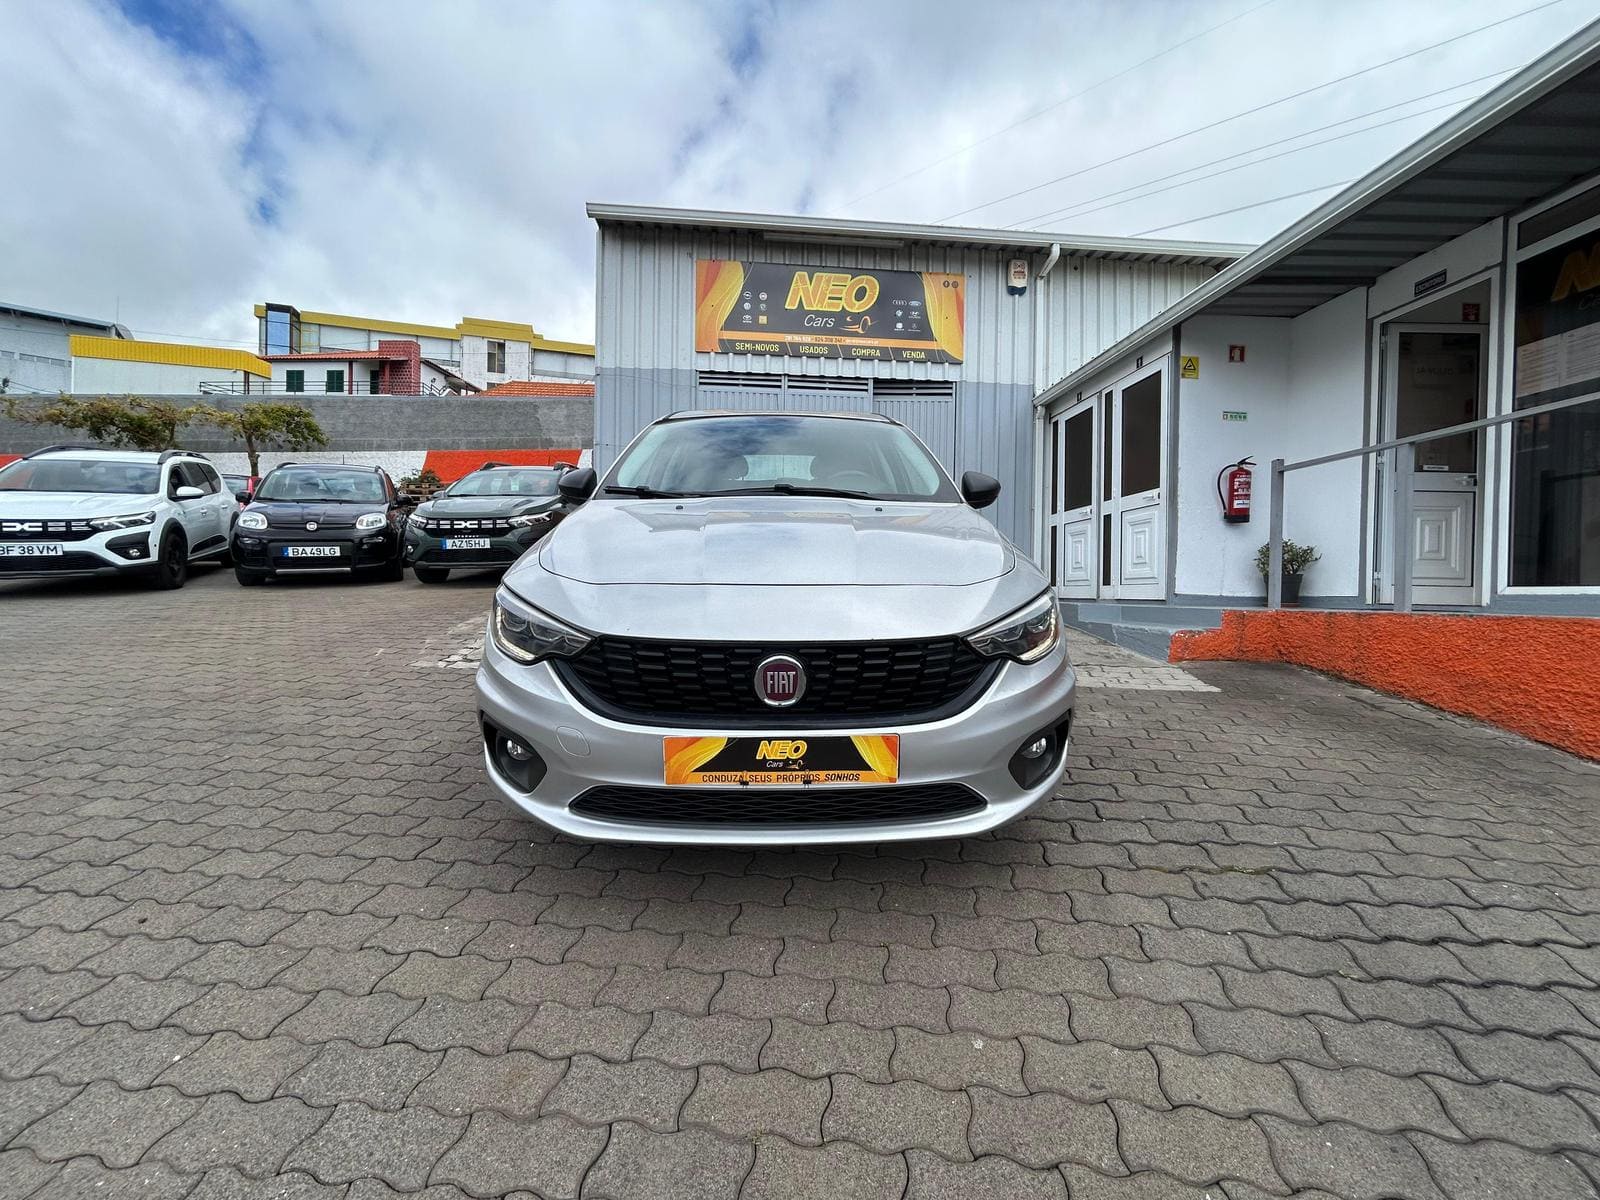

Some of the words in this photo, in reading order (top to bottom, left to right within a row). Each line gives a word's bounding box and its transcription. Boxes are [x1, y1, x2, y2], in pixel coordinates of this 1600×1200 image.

[785, 271, 879, 313] NEO
[804, 315, 835, 327] Cars
[735, 342, 779, 352] SEMI-NOVOS
[799, 345, 828, 354] USADOS
[851, 347, 881, 357] COMPRA
[902, 350, 926, 359] VENDA
[766, 671, 796, 694] FIAT
[755, 740, 808, 760] NEO
[766, 760, 784, 768] Cars
[702, 774, 745, 783] CONDUZA
[748, 774, 772, 783] SEUS
[824, 773, 861, 782] SONHOS
